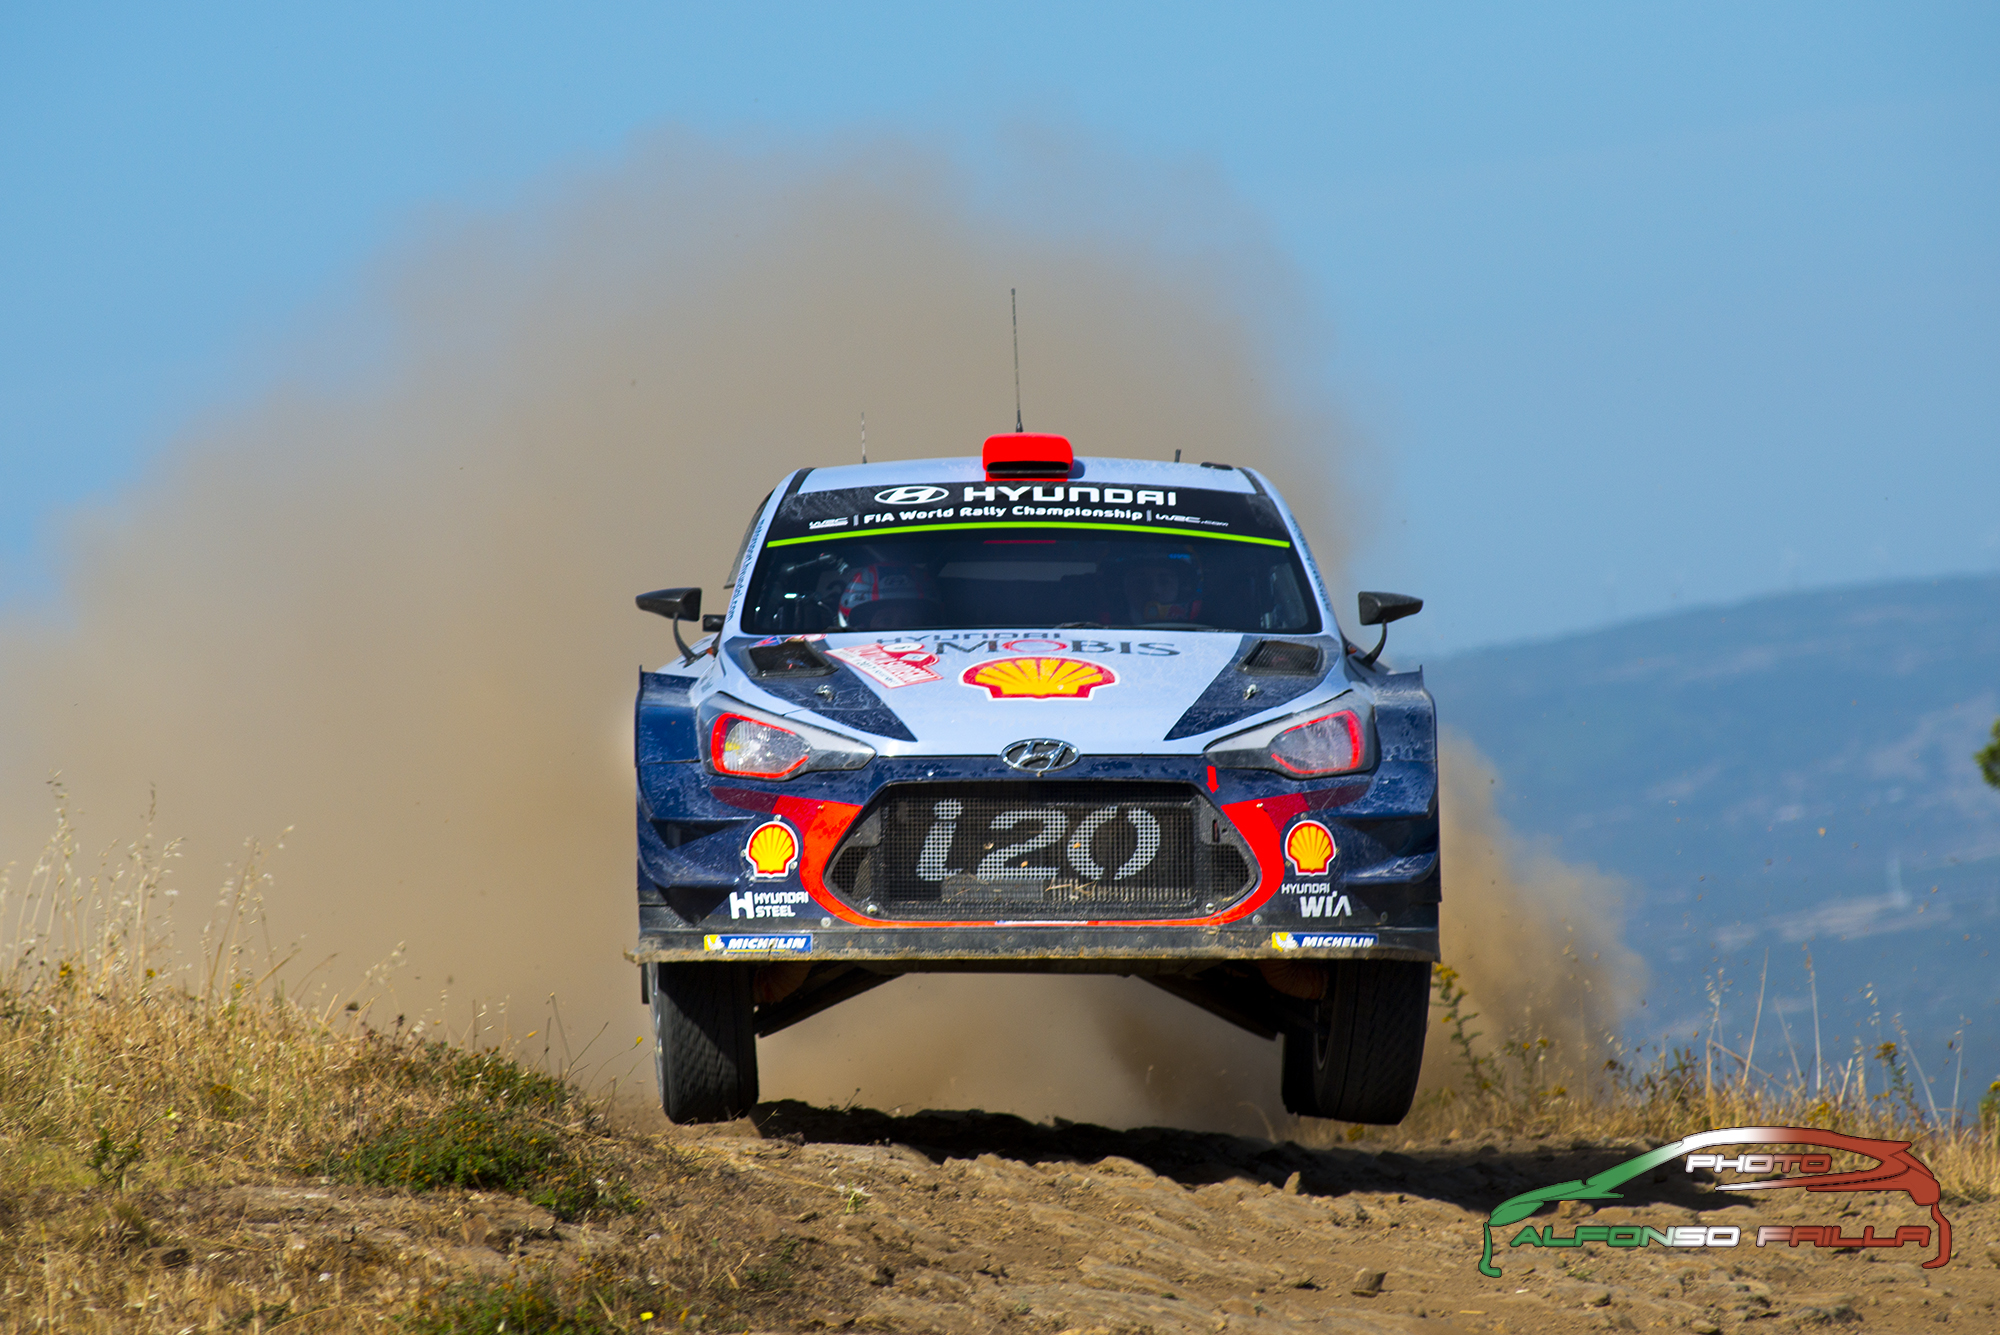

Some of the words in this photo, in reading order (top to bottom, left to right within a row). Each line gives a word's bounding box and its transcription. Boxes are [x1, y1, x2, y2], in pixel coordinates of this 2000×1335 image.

[963, 485, 1176, 506] HYUNDAI
[863, 511, 895, 524] FIA
[899, 506, 954, 520] World
[959, 506, 1006, 518] Rally
[1011, 506, 1143, 521] Championship
[936, 639, 1181, 657] MOBIS
[916, 799, 1161, 881] i20
[754, 891, 809, 904] HYUNDAI
[1281, 883, 1330, 894] HYUNDAI
[755, 904, 796, 918] STEEL
[1299, 891, 1352, 918] WIA
[1301, 936, 1374, 948] MICHELIN
